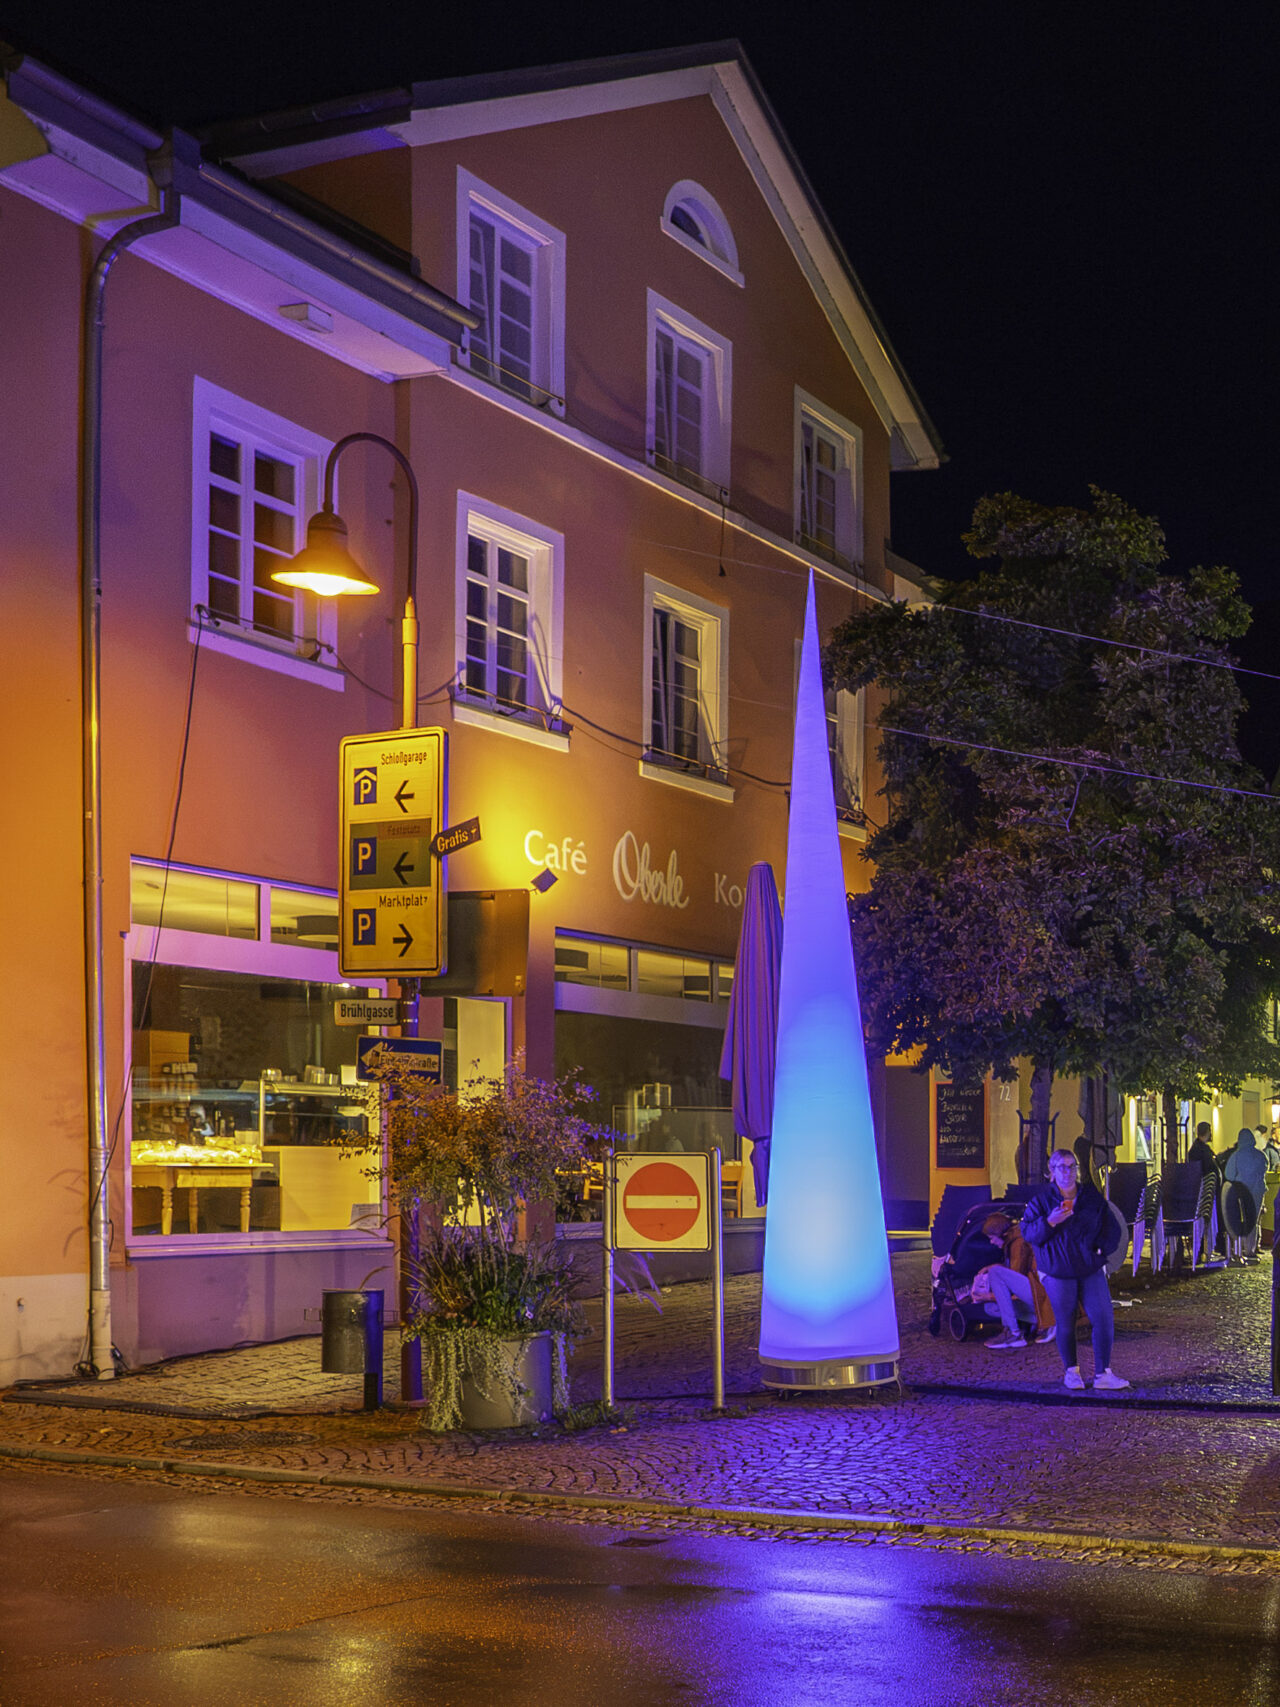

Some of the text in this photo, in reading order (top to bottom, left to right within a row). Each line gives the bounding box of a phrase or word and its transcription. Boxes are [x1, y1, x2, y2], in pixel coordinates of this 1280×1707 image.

[381, 752, 427, 766] Schloßgarage
[437, 829, 469, 852] Gratis
[524, 830, 587, 875] Café
[612, 830, 690, 909] Oberle
[340, 1003, 394, 1021] Brühlgasse
[999, 1085, 1011, 1101] 72
